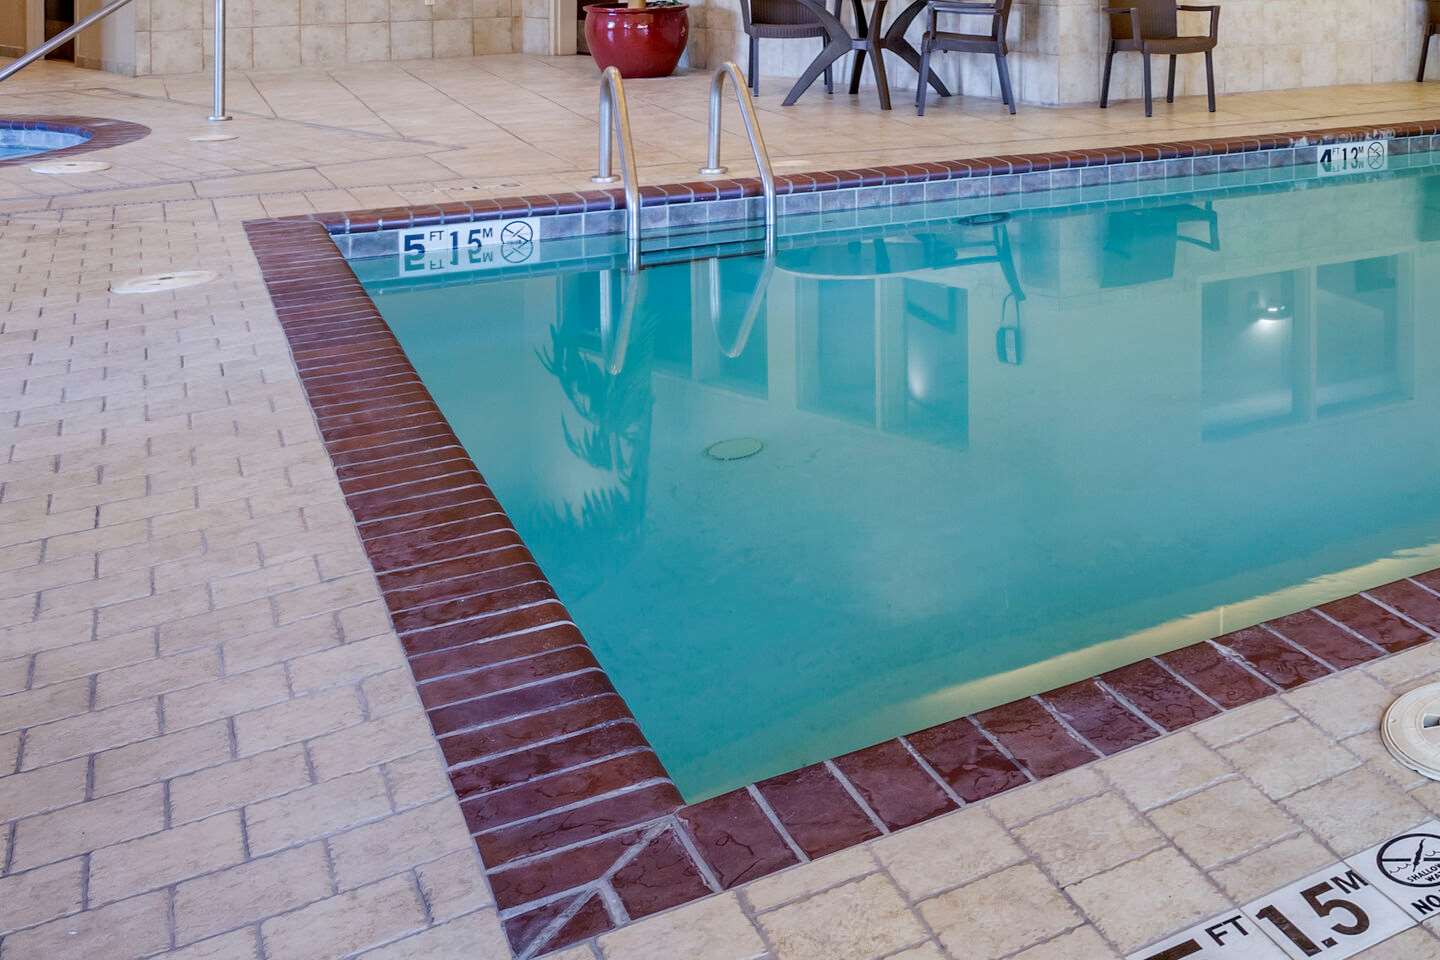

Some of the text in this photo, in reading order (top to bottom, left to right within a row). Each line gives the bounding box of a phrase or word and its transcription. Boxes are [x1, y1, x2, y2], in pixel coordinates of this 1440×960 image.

[404, 233, 426, 254] 5
[429, 230, 444, 241] FT
[482, 227, 493, 239] M
[1204, 869, 1370, 958] FT 1.5 M
